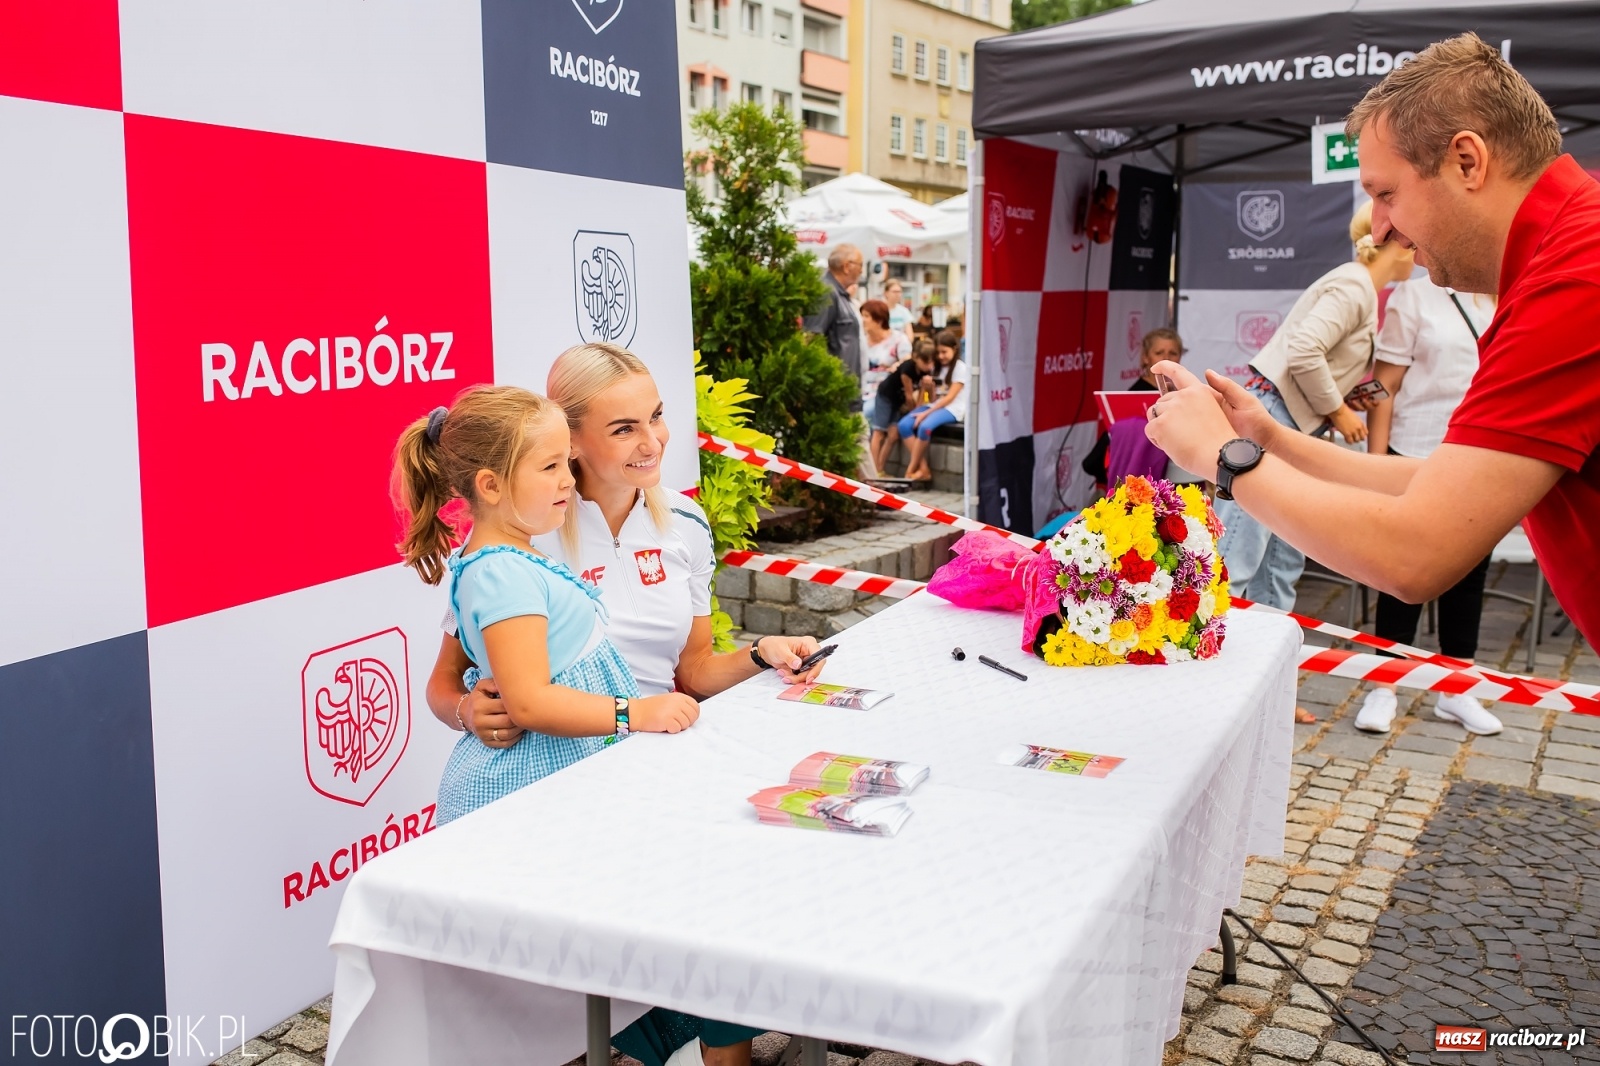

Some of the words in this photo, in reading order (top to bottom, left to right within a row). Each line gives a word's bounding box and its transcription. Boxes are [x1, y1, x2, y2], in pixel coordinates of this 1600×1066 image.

[549, 46, 641, 97] RACIBÓRZ
[1190, 39, 1512, 88] www.racibol
[590, 109, 608, 127] 1217
[201, 315, 455, 402] RACIBÓRZ
[283, 803, 437, 909] RACIBÓRZ
